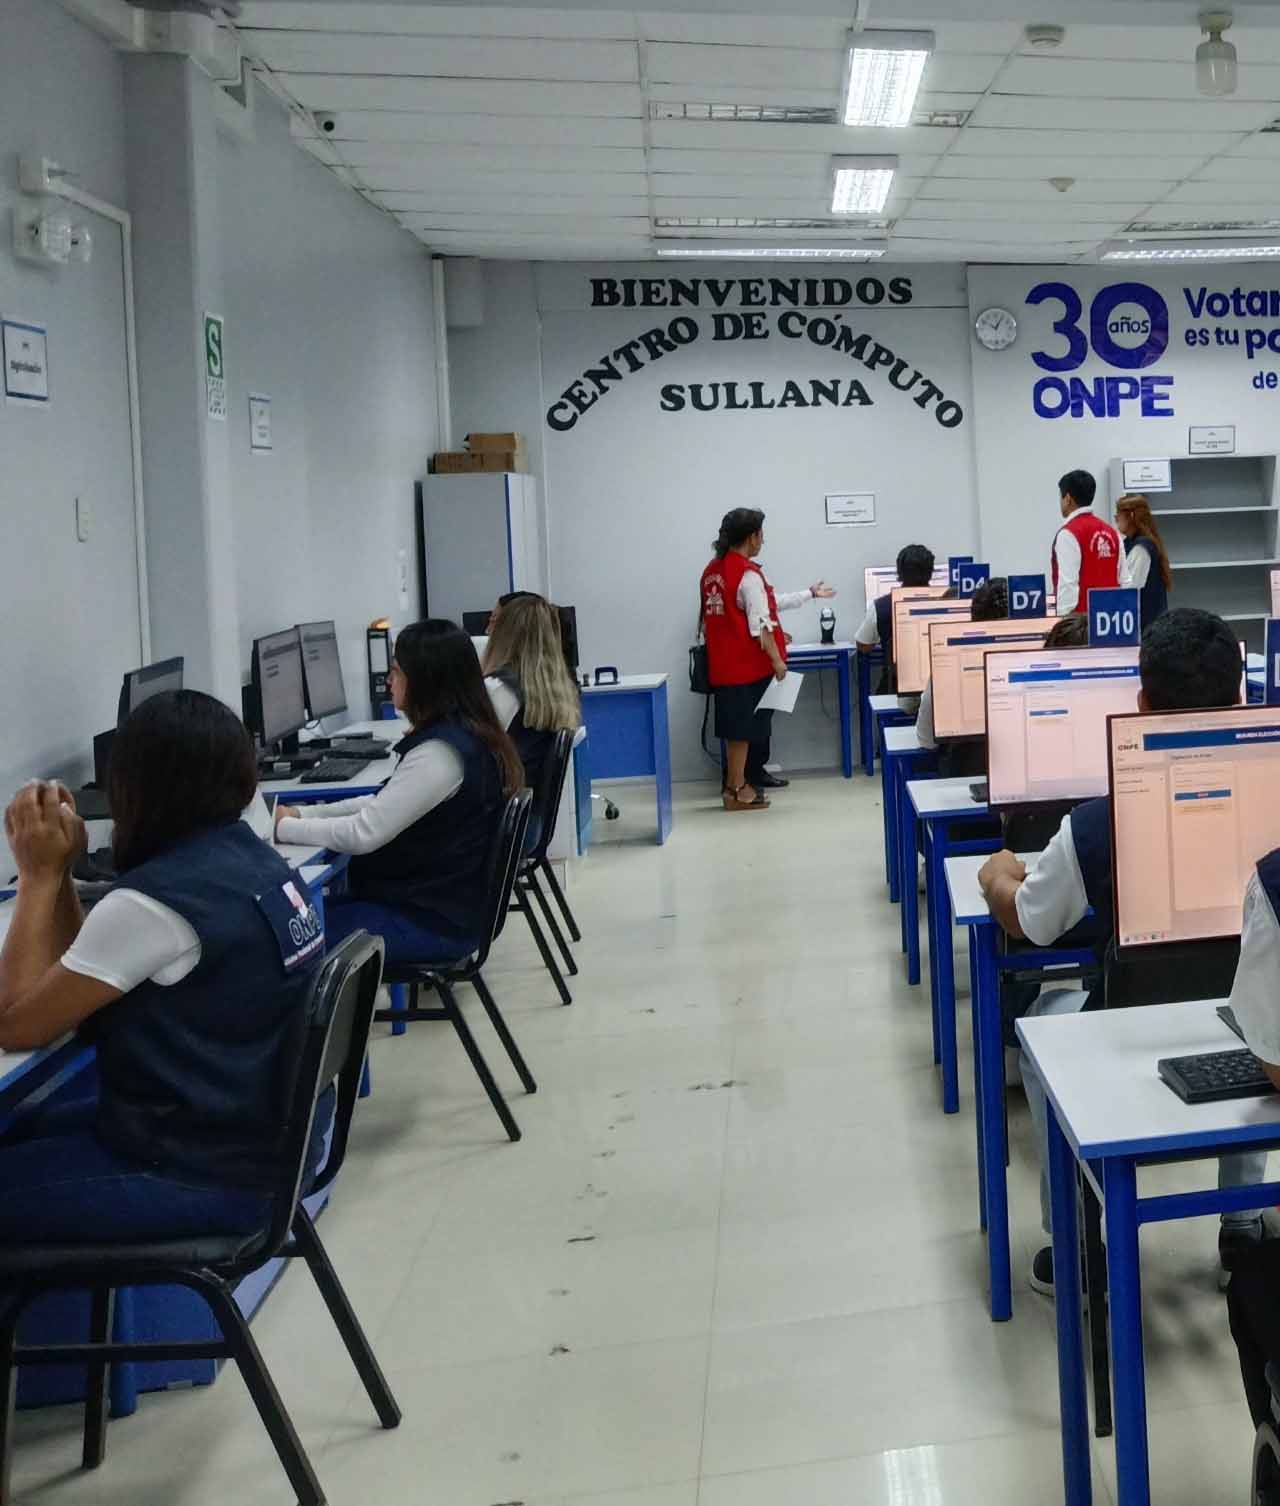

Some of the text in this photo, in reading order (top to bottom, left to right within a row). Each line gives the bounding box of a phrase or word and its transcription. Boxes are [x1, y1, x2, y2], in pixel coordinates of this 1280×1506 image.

[590, 277, 913, 307] BIENVENIDOS
[1024, 281, 1170, 373] 30
[1108, 314, 1151, 336] años
[1184, 327, 1210, 347] es
[1214, 326, 1240, 347] tu
[546, 311, 965, 432] CENTRO DE CÓMPUTO
[1252, 370, 1279, 390] de
[659, 379, 875, 412] SULLANA
[1032, 375, 1175, 419] ONPE
[1012, 590, 1042, 610] D7
[1096, 610, 1135, 637] D10
